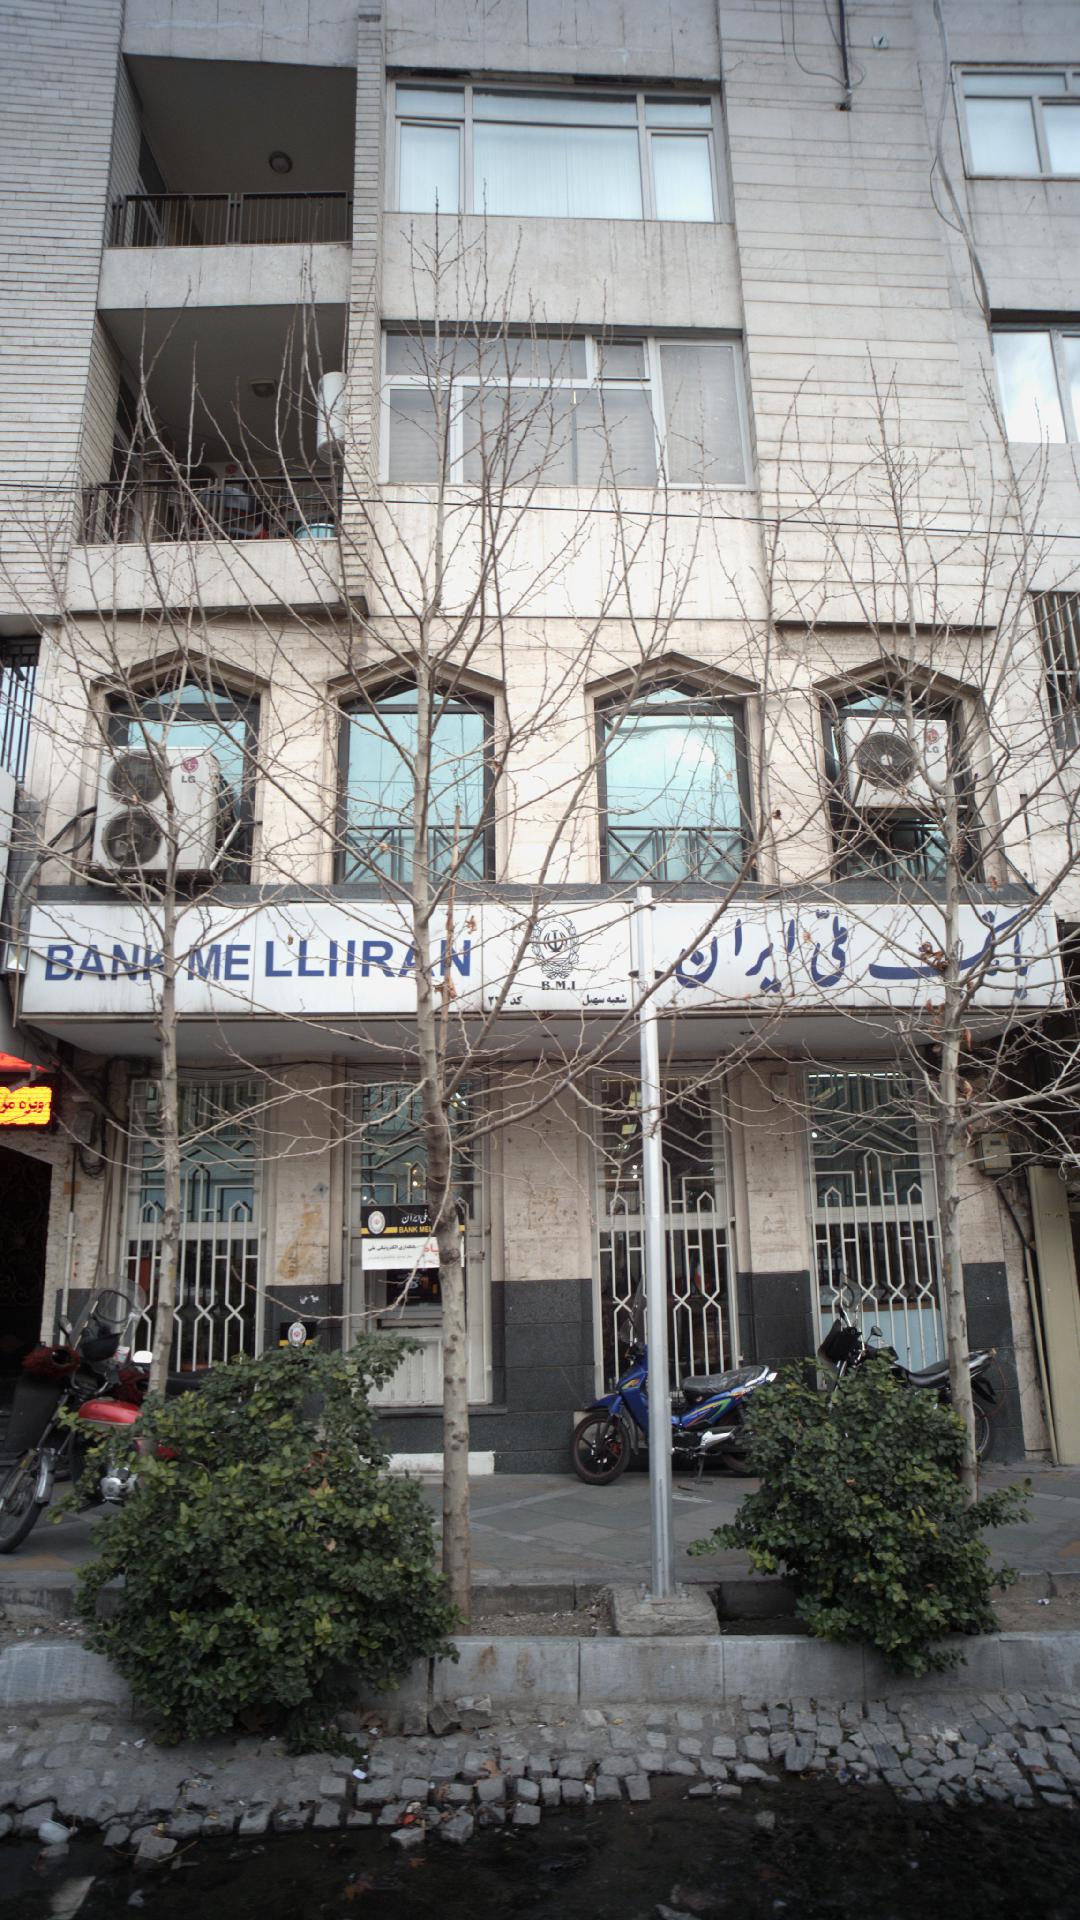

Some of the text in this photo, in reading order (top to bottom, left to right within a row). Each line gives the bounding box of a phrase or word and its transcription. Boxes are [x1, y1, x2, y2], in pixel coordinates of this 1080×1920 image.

[181, 775, 196, 784] LG
[45, 944, 168, 981] BANK
[675, 919, 795, 993] ایران
[398, 1226, 418, 1234] BANK
